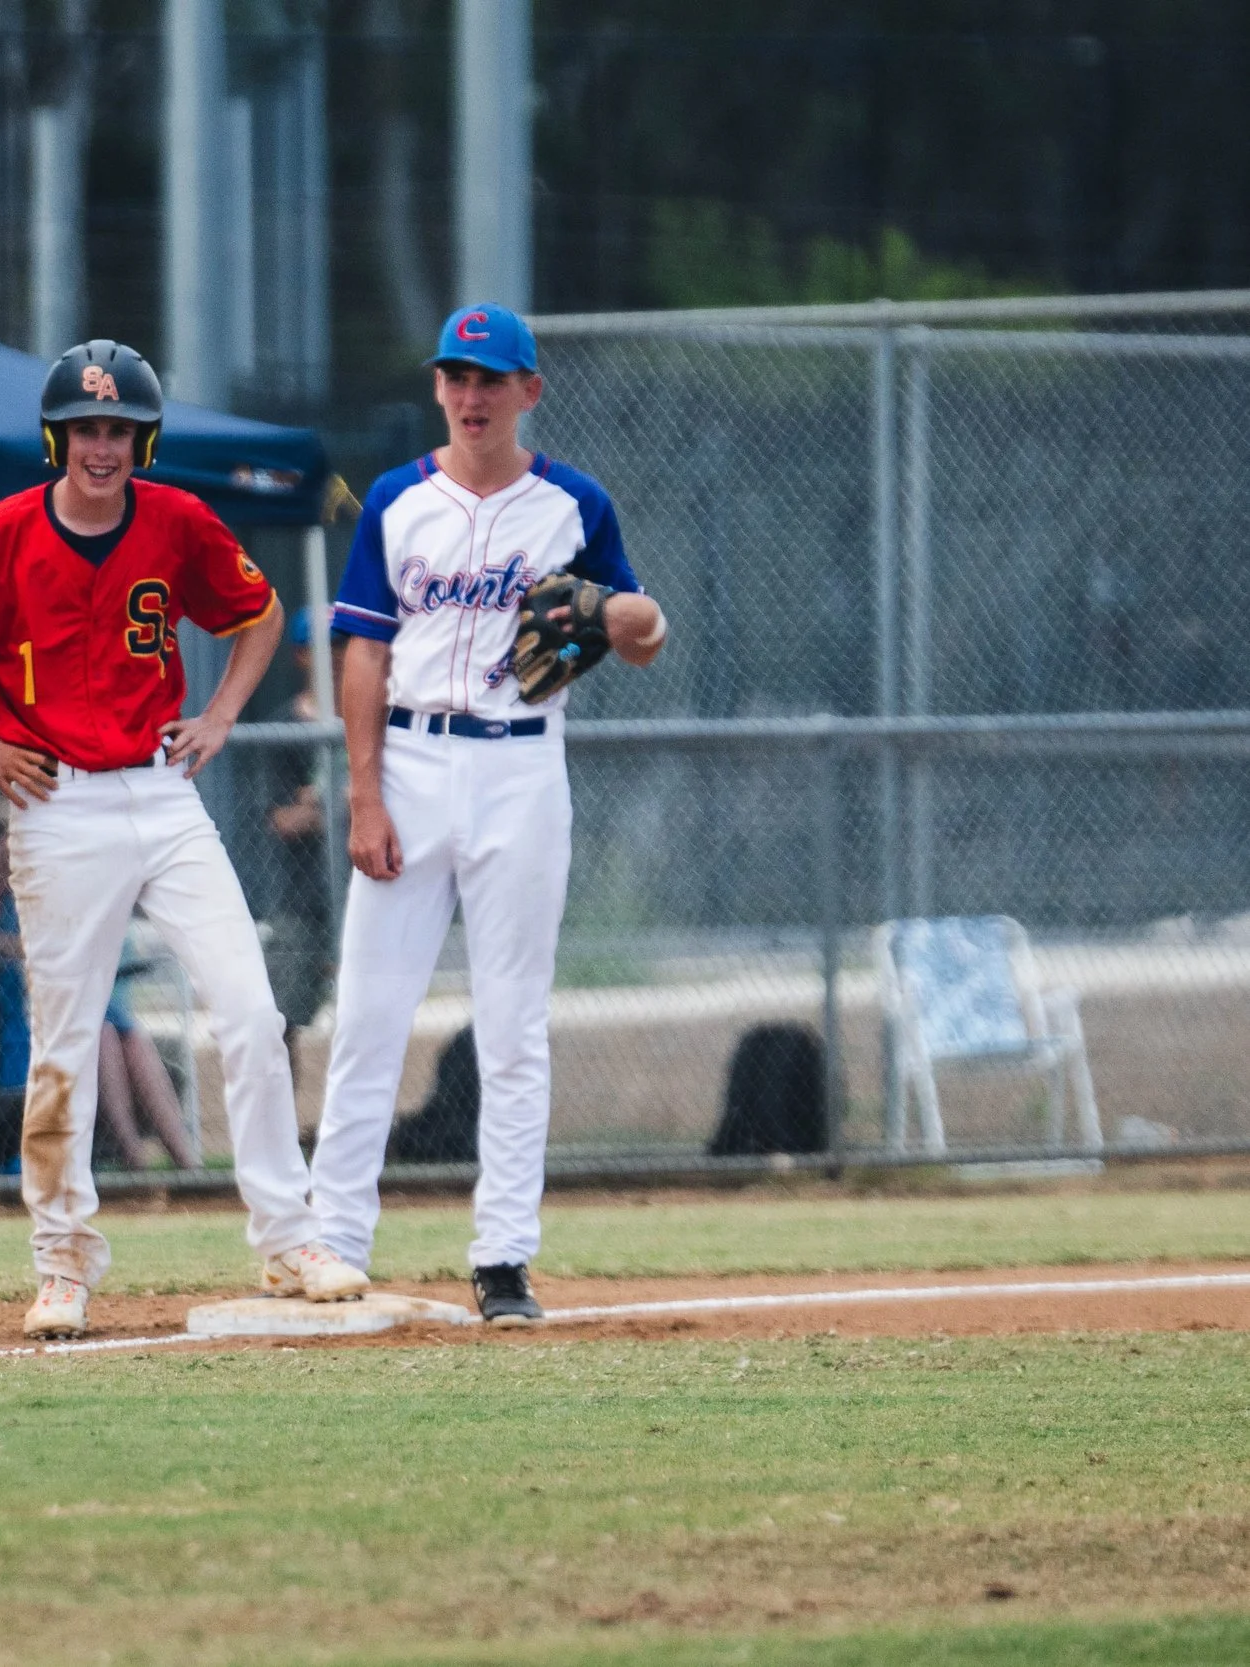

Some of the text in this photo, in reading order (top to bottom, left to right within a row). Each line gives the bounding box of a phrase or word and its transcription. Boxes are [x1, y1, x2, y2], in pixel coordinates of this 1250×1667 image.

[456, 311, 490, 342] C
[82, 365, 120, 401] SA
[398, 550, 538, 616] Count
[19, 641, 35, 705] 1
